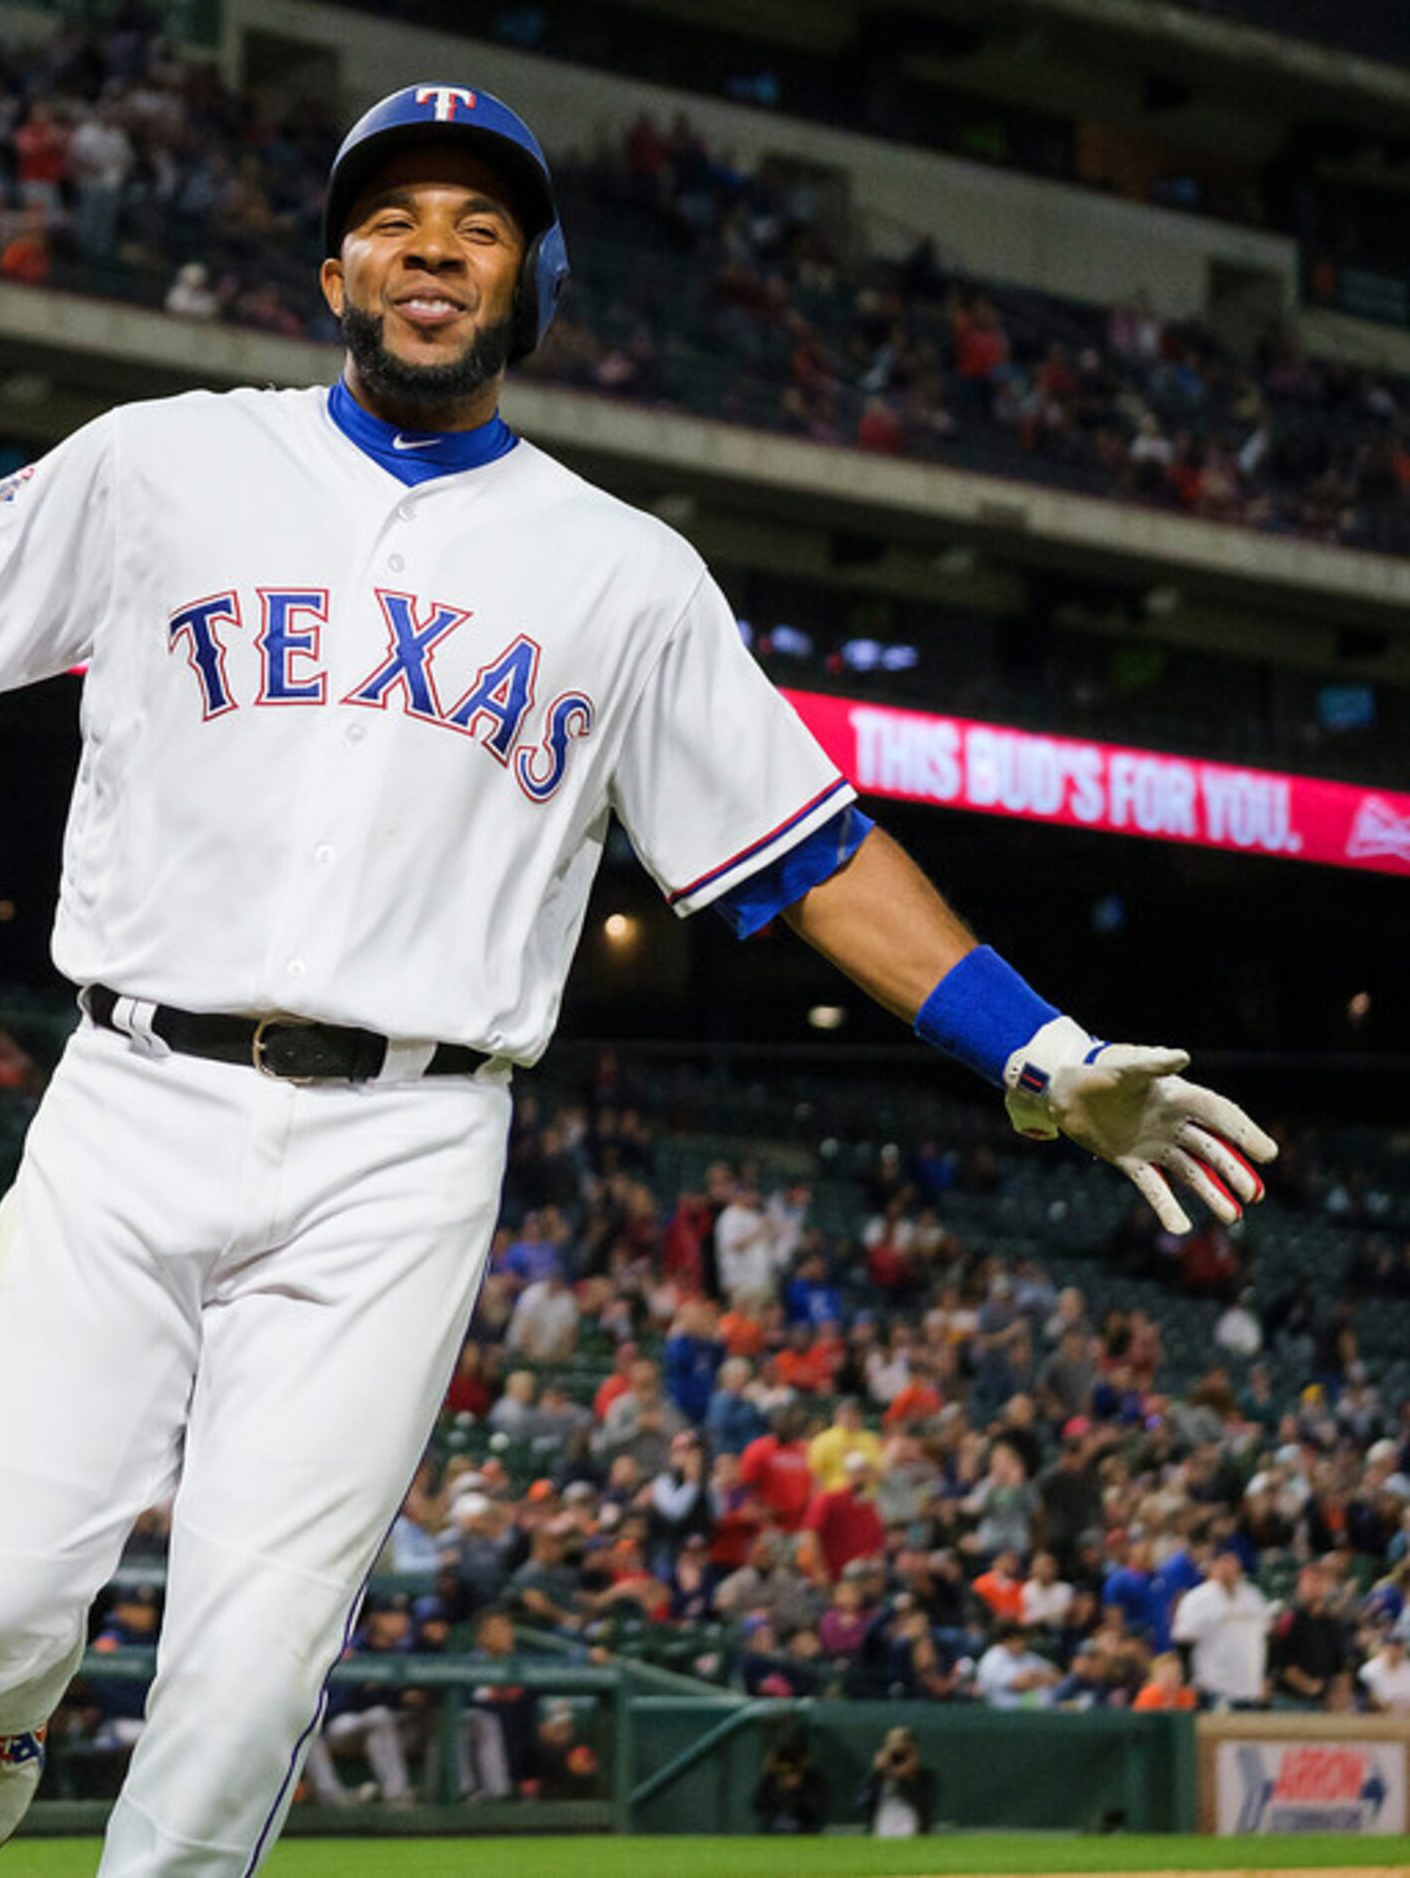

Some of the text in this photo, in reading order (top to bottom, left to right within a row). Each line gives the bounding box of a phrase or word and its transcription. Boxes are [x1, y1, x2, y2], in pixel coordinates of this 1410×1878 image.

[415, 87, 476, 121] T
[168, 586, 596, 804] TEXAS
[848, 707, 1304, 854] THIS BUD'S FOR YOU.
